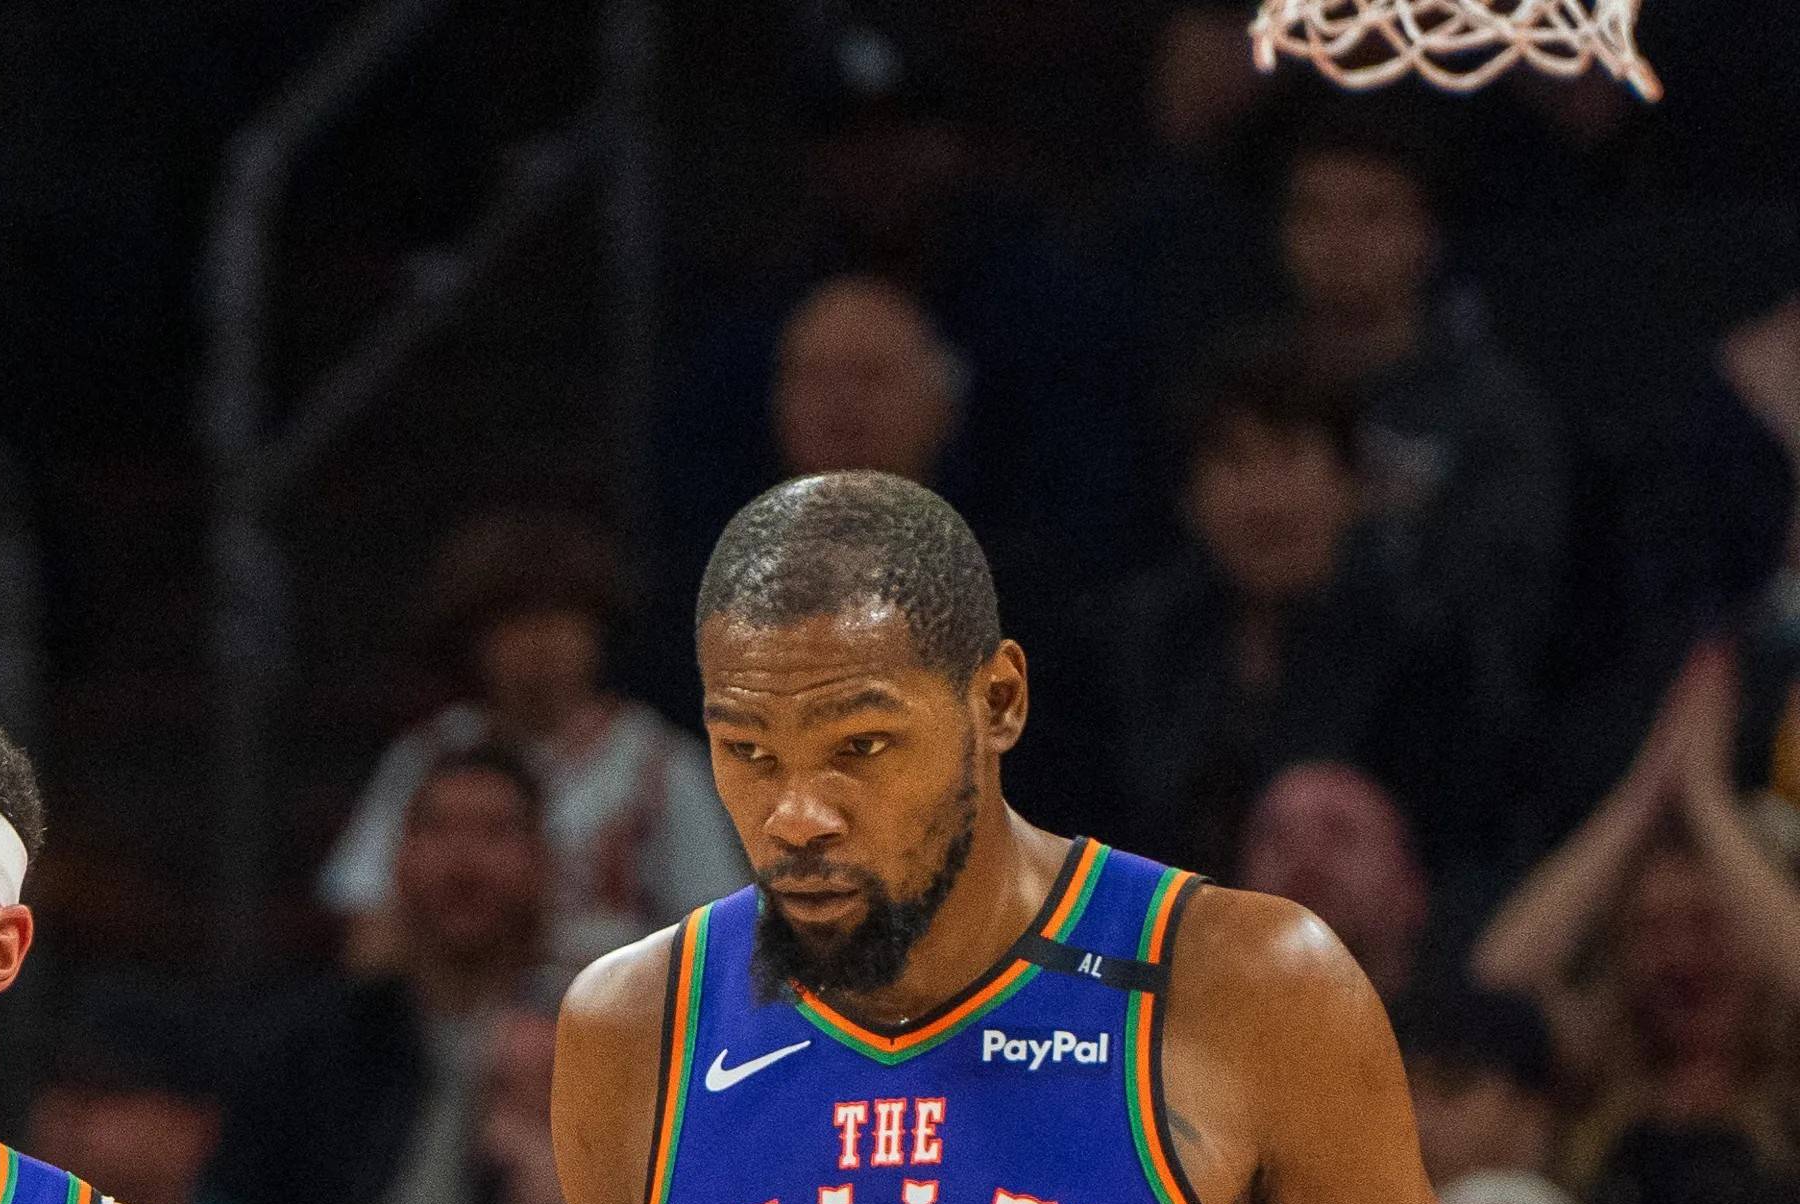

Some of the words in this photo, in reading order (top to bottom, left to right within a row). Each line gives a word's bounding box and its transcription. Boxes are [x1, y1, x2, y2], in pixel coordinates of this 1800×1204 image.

[1078, 953, 1102, 977] AL
[983, 1030, 1109, 1070] PayPal
[833, 1098, 946, 1168] THE
